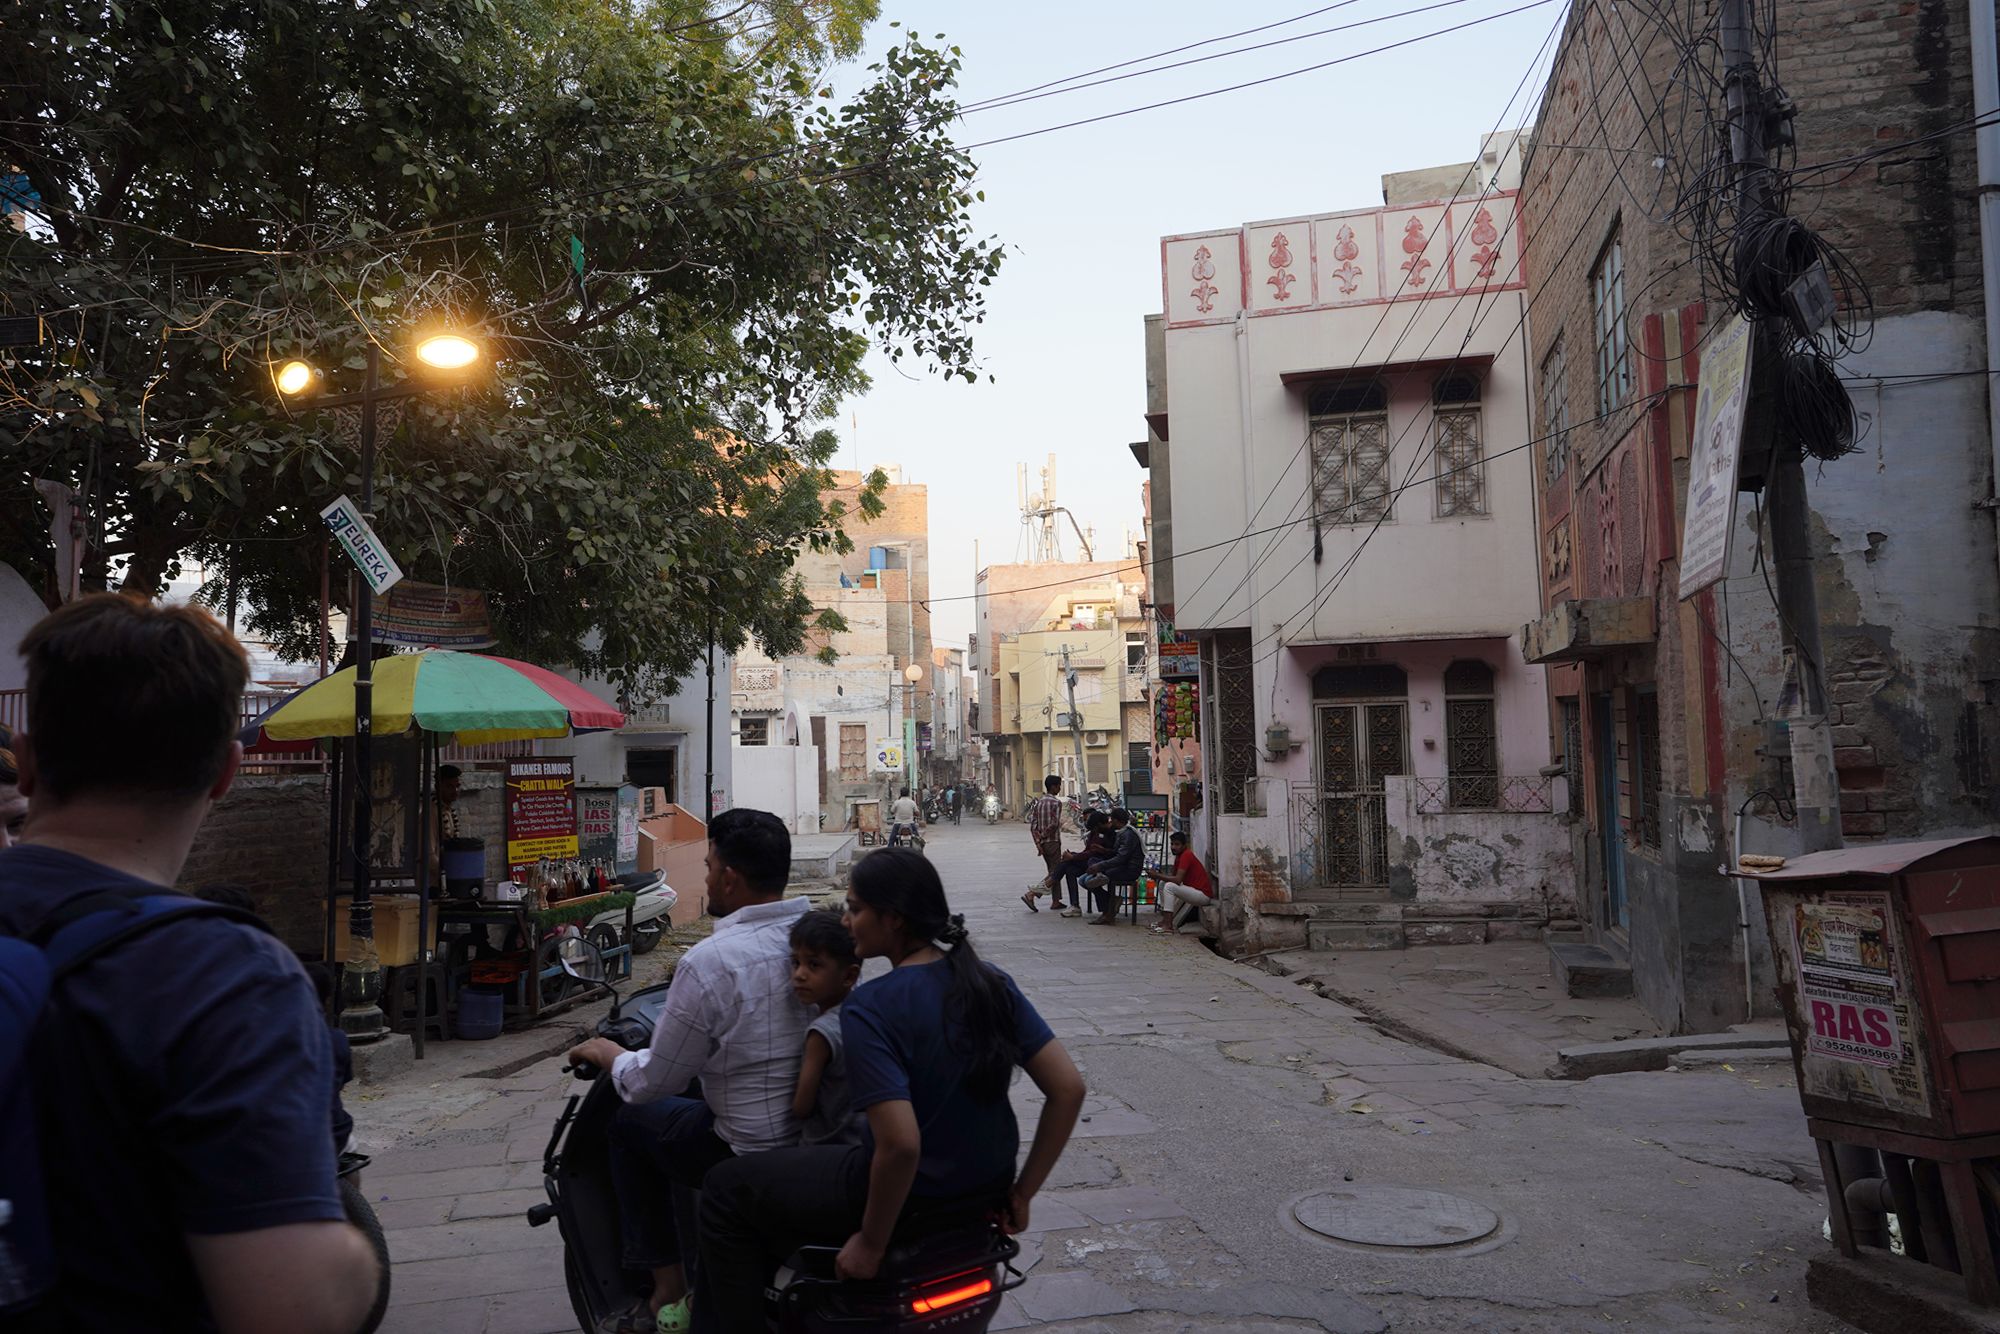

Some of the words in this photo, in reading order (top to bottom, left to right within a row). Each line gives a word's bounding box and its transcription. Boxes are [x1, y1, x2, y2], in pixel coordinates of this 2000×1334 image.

[344, 525, 388, 583] EUREKA
[511, 763, 542, 776] BIKANER
[543, 763, 571, 775] FAMOUS
[520, 780, 546, 791] CHATTA
[546, 779, 564, 790] WALA
[584, 809, 610, 820] IAS
[584, 823, 610, 833] RAS
[1811, 1000, 1892, 1048] RAS
[1825, 1040, 1898, 1060] 9529495969
[928, 1308, 980, 1330] ATHER
